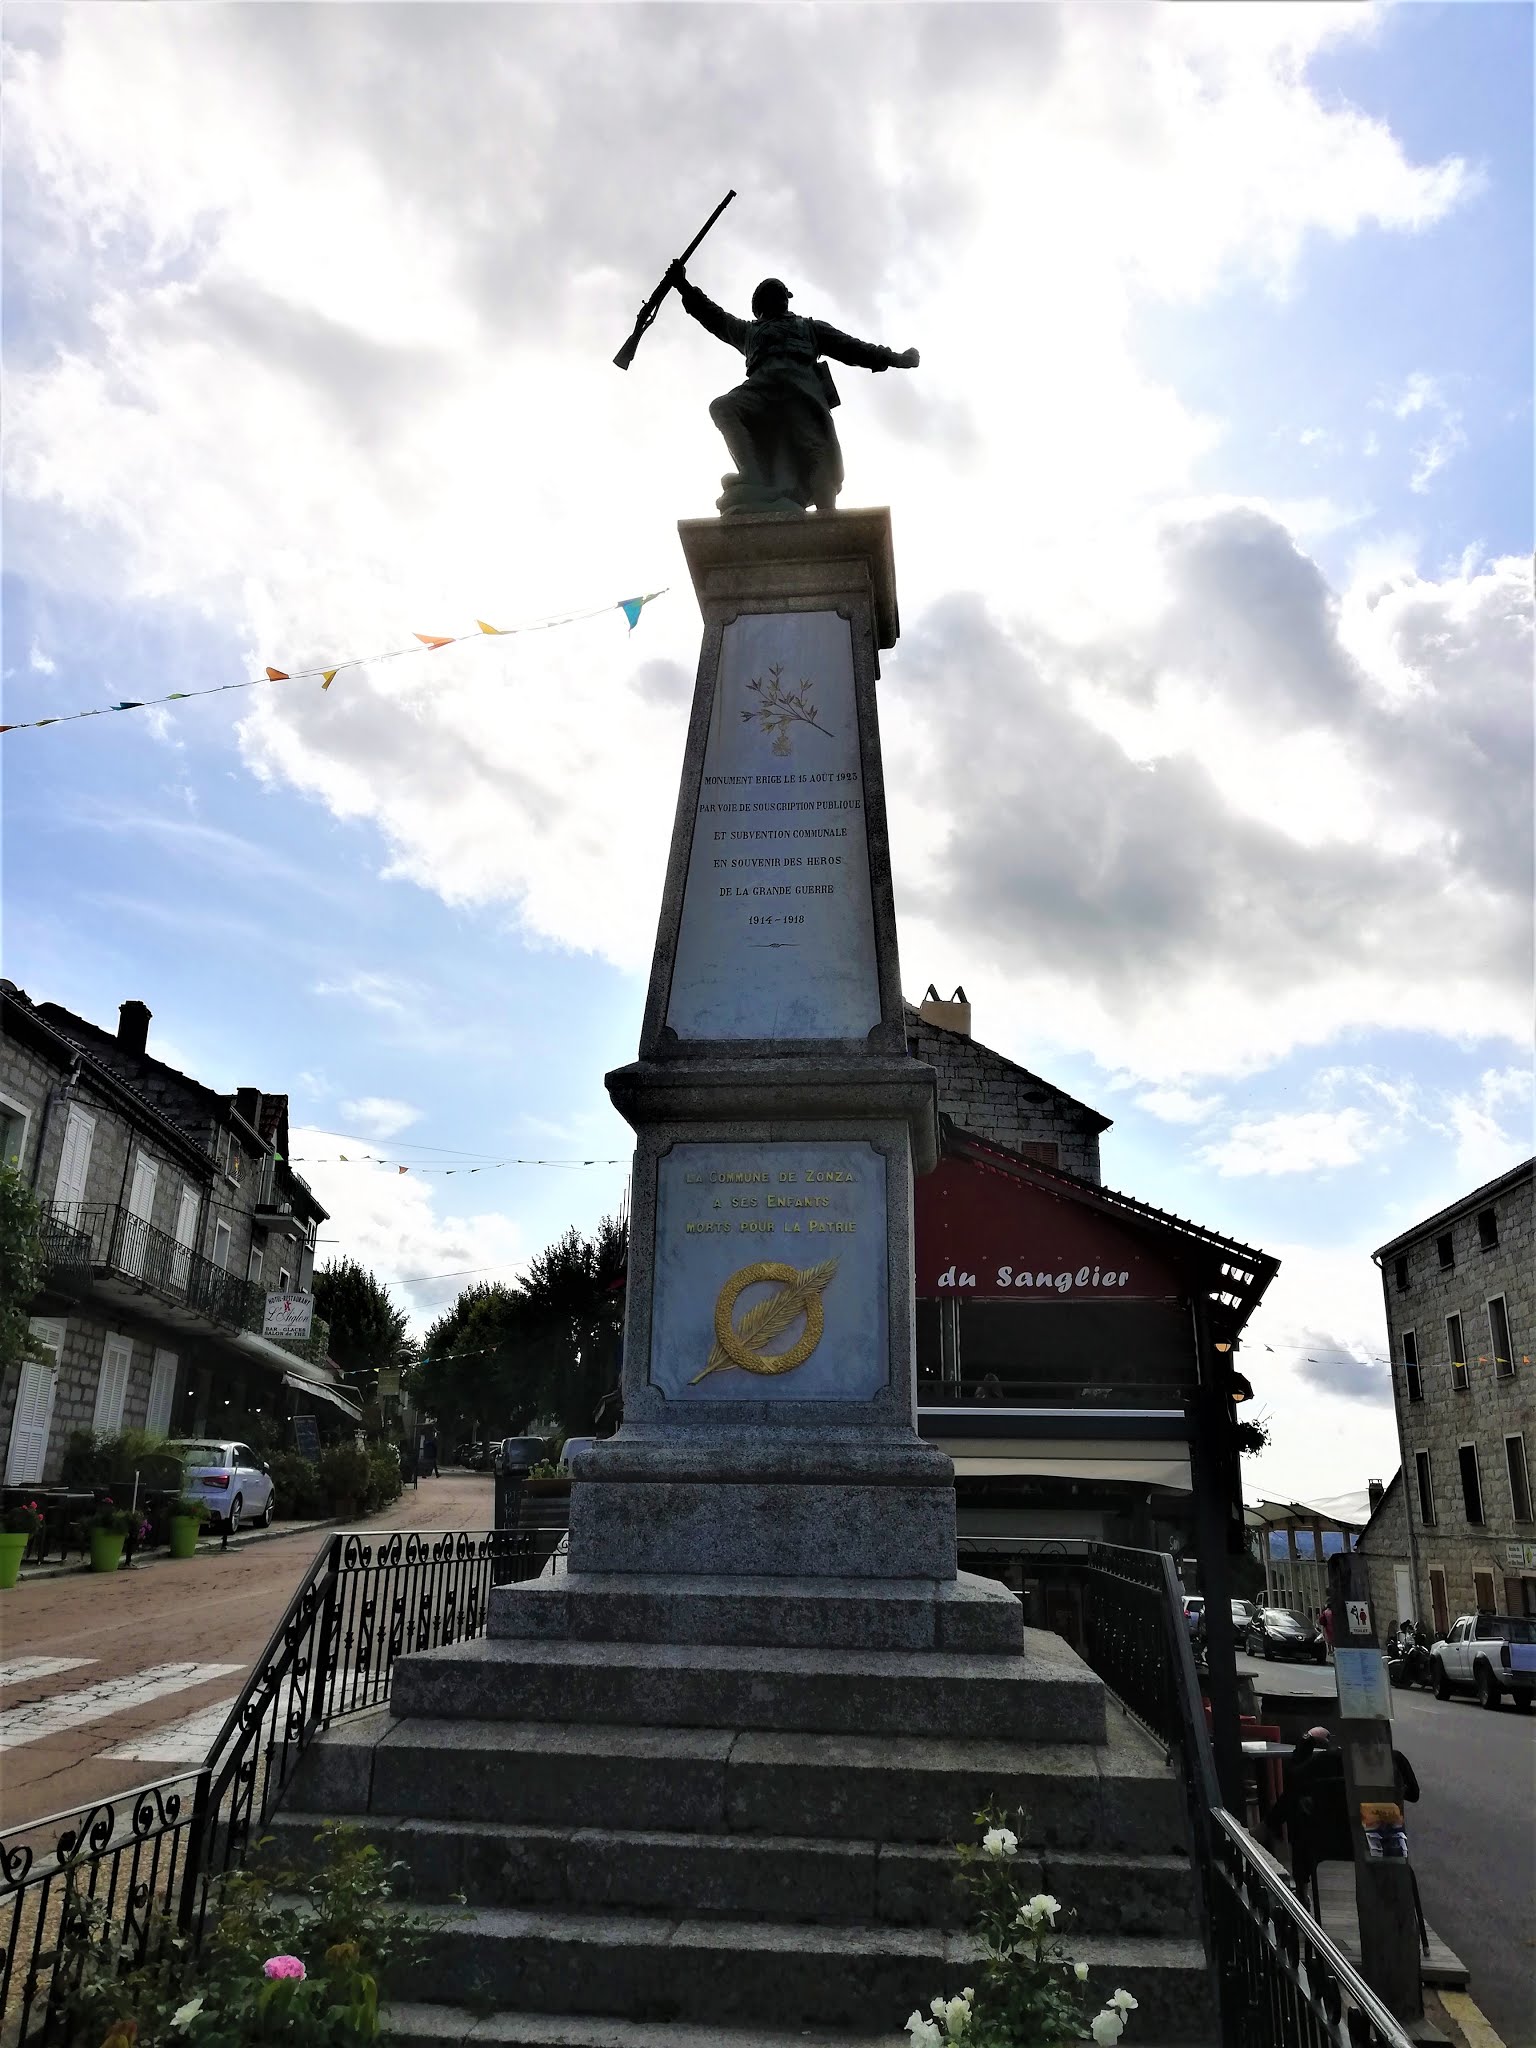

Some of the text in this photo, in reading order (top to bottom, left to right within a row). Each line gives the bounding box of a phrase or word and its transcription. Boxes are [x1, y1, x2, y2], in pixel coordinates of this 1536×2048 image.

[704, 776, 753, 785] MONUMENT
[755, 775, 782, 784] ERIGE
[784, 774, 796, 784] LE
[798, 774, 807, 783] 15
[699, 800, 861, 813] PAR VOIE DE SOUSCRIPTION PUBLIQUE
[713, 828, 847, 840] ET SUBVENTION COMMUNALE
[713, 856, 842, 868] EN SOUVENIR DES HEROS
[719, 884, 834, 897] DE LA GRANDE GUERRE
[686, 1221, 731, 1233] MORTS
[740, 1221, 775, 1233] POUR
[784, 1221, 801, 1233] LA
[937, 1265, 1129, 1293] du Sanglier
